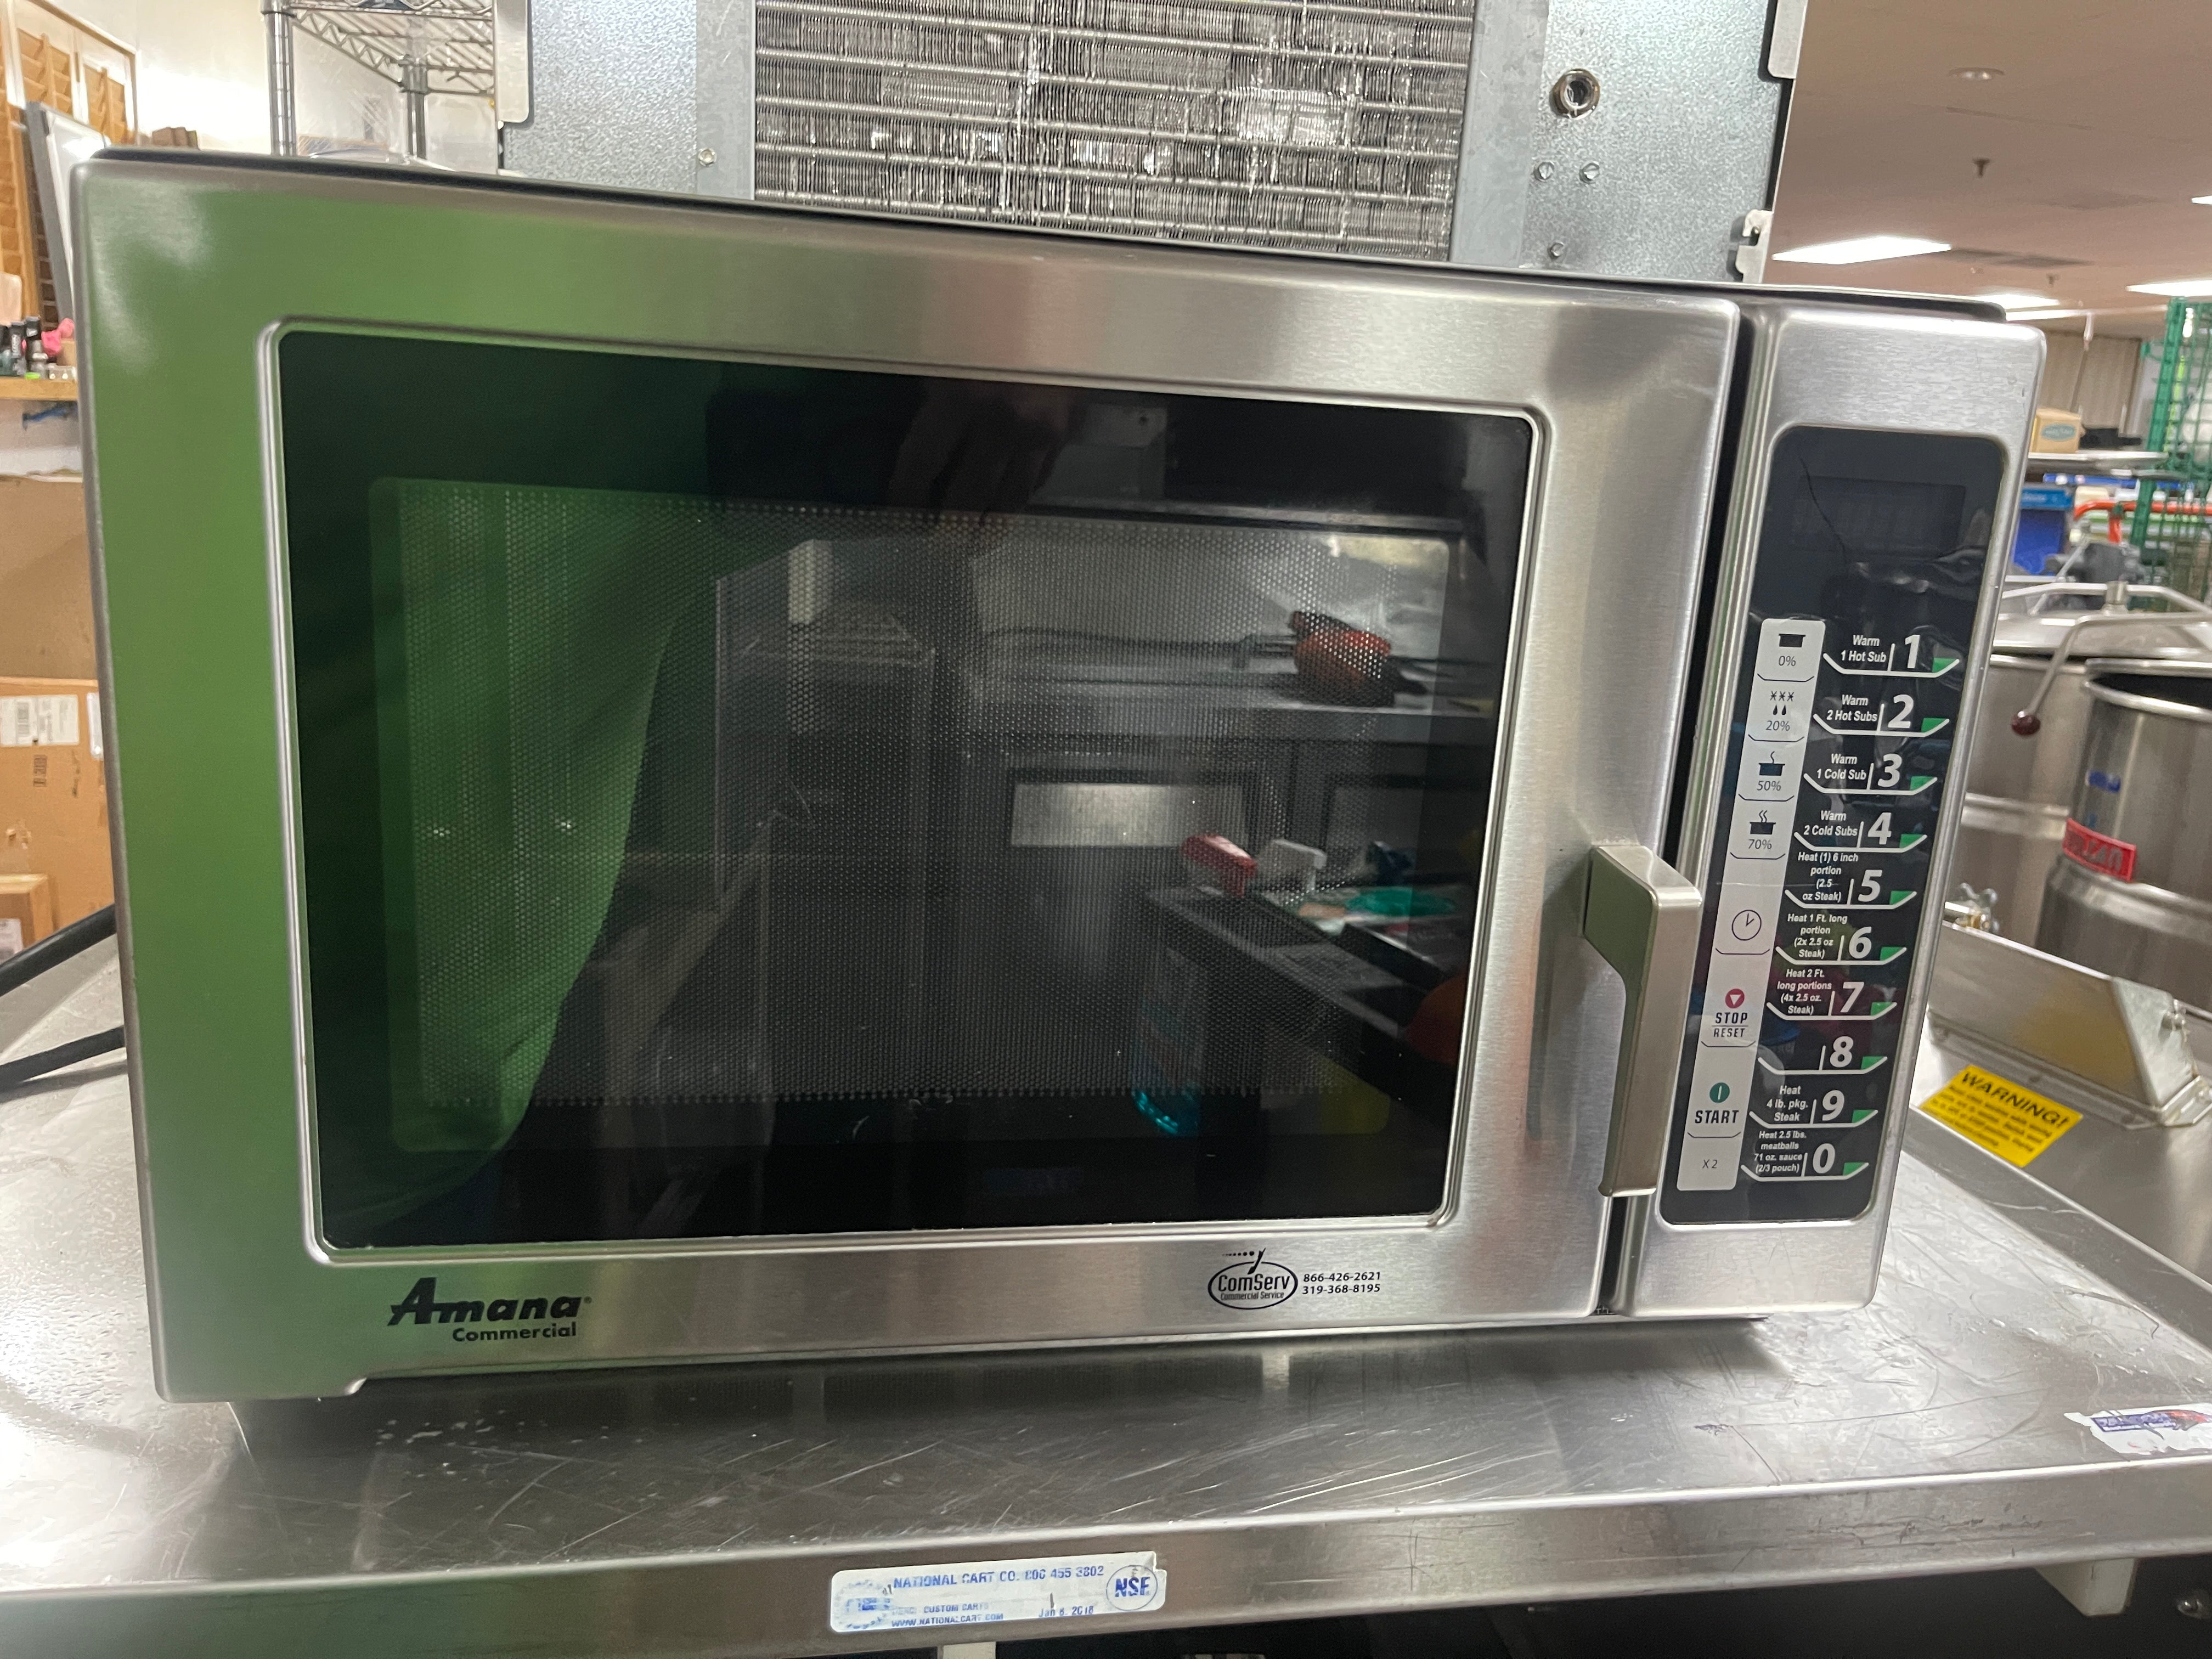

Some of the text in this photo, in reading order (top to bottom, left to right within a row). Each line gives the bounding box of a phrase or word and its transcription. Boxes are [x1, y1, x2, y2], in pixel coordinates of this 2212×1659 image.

[1853, 635, 1880, 646] Warm
[1841, 650, 1887, 662] 1 Hot Sub
[1905, 634, 1920, 669] 1
[1778, 656, 1796, 667] 0%
[1842, 695, 1868, 706] Warm
[1827, 710, 1877, 721] 2 Hot Subs
[1888, 695, 1914, 729] 2
[1765, 720, 1790, 731] 20%
[1831, 754, 1857, 764] Warm
[1817, 769, 1866, 780] 1 Cold Sub
[1878, 754, 1902, 787] 3
[1757, 781, 1781, 791] 50%
[1821, 810, 1847, 821] Warm
[1804, 825, 1858, 836] 2 Cold Subs
[1867, 812, 1892, 844] 4
[1748, 839, 1772, 849] 70%
[1798, 852, 1818, 861] Heat
[1820, 853, 1831, 864] (1)
[1840, 853, 1858, 862] inch
[1810, 866, 1842, 876] portion
[1816, 879, 1832, 889] (2.5
[1858, 870, 1882, 902] 5
[1815, 891, 1842, 902] Steak)
[1829, 915, 1848, 924] long
[1801, 926, 1831, 935] portion
[1795, 938, 1807, 947] (2x
[1809, 938, 1822, 946] 2.5
[1849, 927, 1872, 959] 6
[1799, 949, 1825, 959] Steak)
[1786, 969, 1805, 978] Heat
[1814, 969, 1825, 978] Ft.
[1778, 981, 1832, 991] long portions
[1781, 993, 1793, 1003] (4x
[1840, 981, 1864, 1012] 7
[1788, 1005, 1814, 1015] Steak)
[1716, 1012, 1748, 1024] STOP
[1713, 1028, 1746, 1037] RESET
[1830, 1036, 1853, 1068] 8
[1780, 1085, 1801, 1094] Heat
[1767, 1099, 1808, 1110] 4 lb. pkg.
[1962, 1071, 2070, 1128] WARNING!
[1822, 1090, 1844, 1121] 9
[1695, 1110, 1739, 1124] START
[1774, 1112, 1800, 1121] Steak
[1759, 1131, 1777, 1139] Heat
[1761, 1142, 1799, 1150] meatballs
[1813, 1143, 1835, 1173] 0
[1756, 1164, 1799, 1173] (2/3 pouch)
[1218, 1273, 1290, 1291] ComServ
[1304, 1272, 1380, 1283] 866-426-2621
[1302, 1284, 1380, 1295] 319-368-8195
[387, 1277, 582, 1326] Amana
[1221, 1292, 1259, 1300] Commercial
[452, 1322, 577, 1342] Commercial
[894, 1575, 957, 1588] NATIONAL
[962, 1572, 994, 1583] CART
[1000, 1571, 1019, 1581] CO.
[1051, 1567, 1071, 1578] 455
[1115, 1577, 1150, 1597] NSF
[924, 1604, 958, 1613] CUSTOM
[1039, 1607, 1055, 1617] Jan
